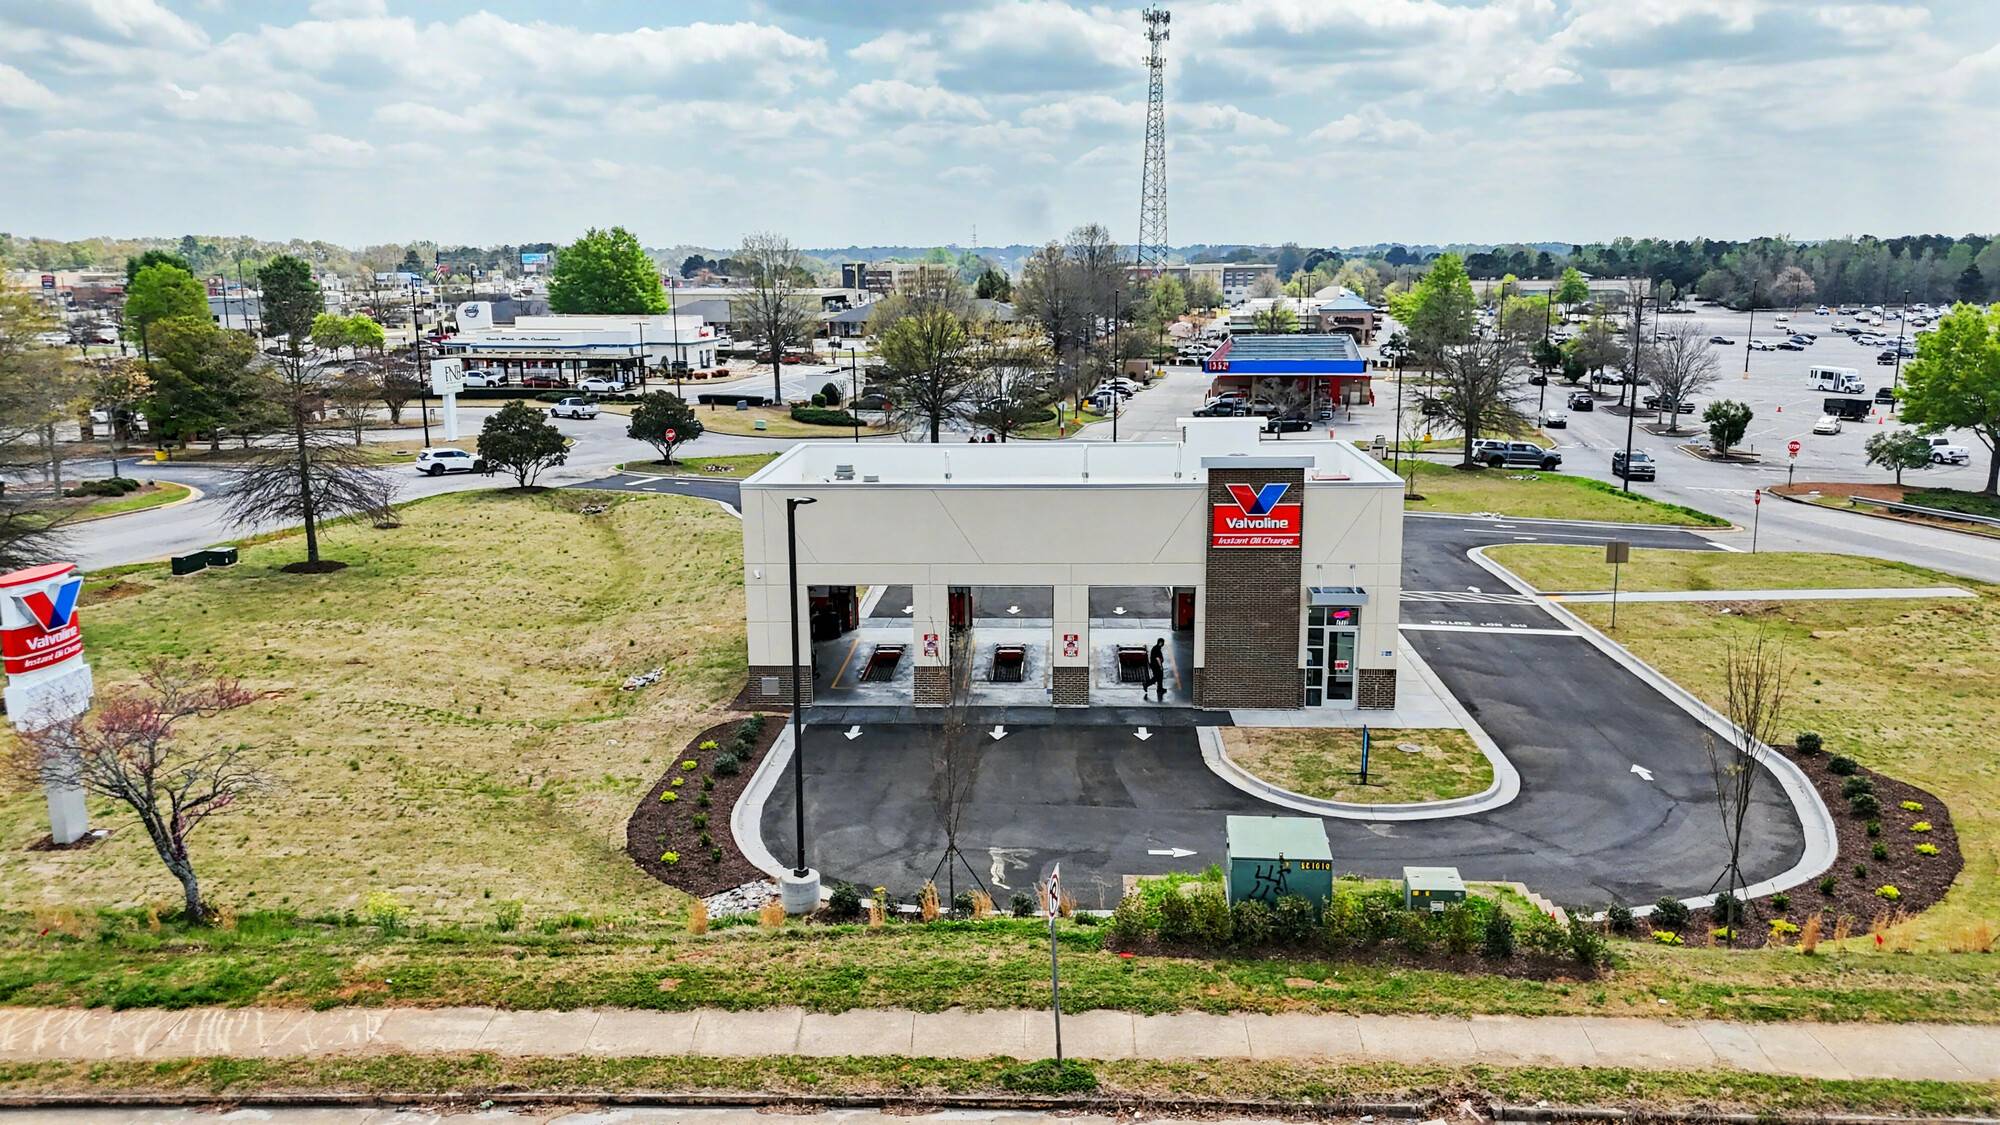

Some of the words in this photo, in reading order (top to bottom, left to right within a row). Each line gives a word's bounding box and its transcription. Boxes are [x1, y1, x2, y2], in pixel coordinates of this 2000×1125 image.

[1226, 517, 1289, 529] Valvoline
[1218, 537, 1249, 545] Instant
[1249, 537, 1261, 545] Oil
[1262, 537, 1294, 546] Change
[26, 626, 77, 650] Valvoline
[24, 653, 54, 668] Instant
